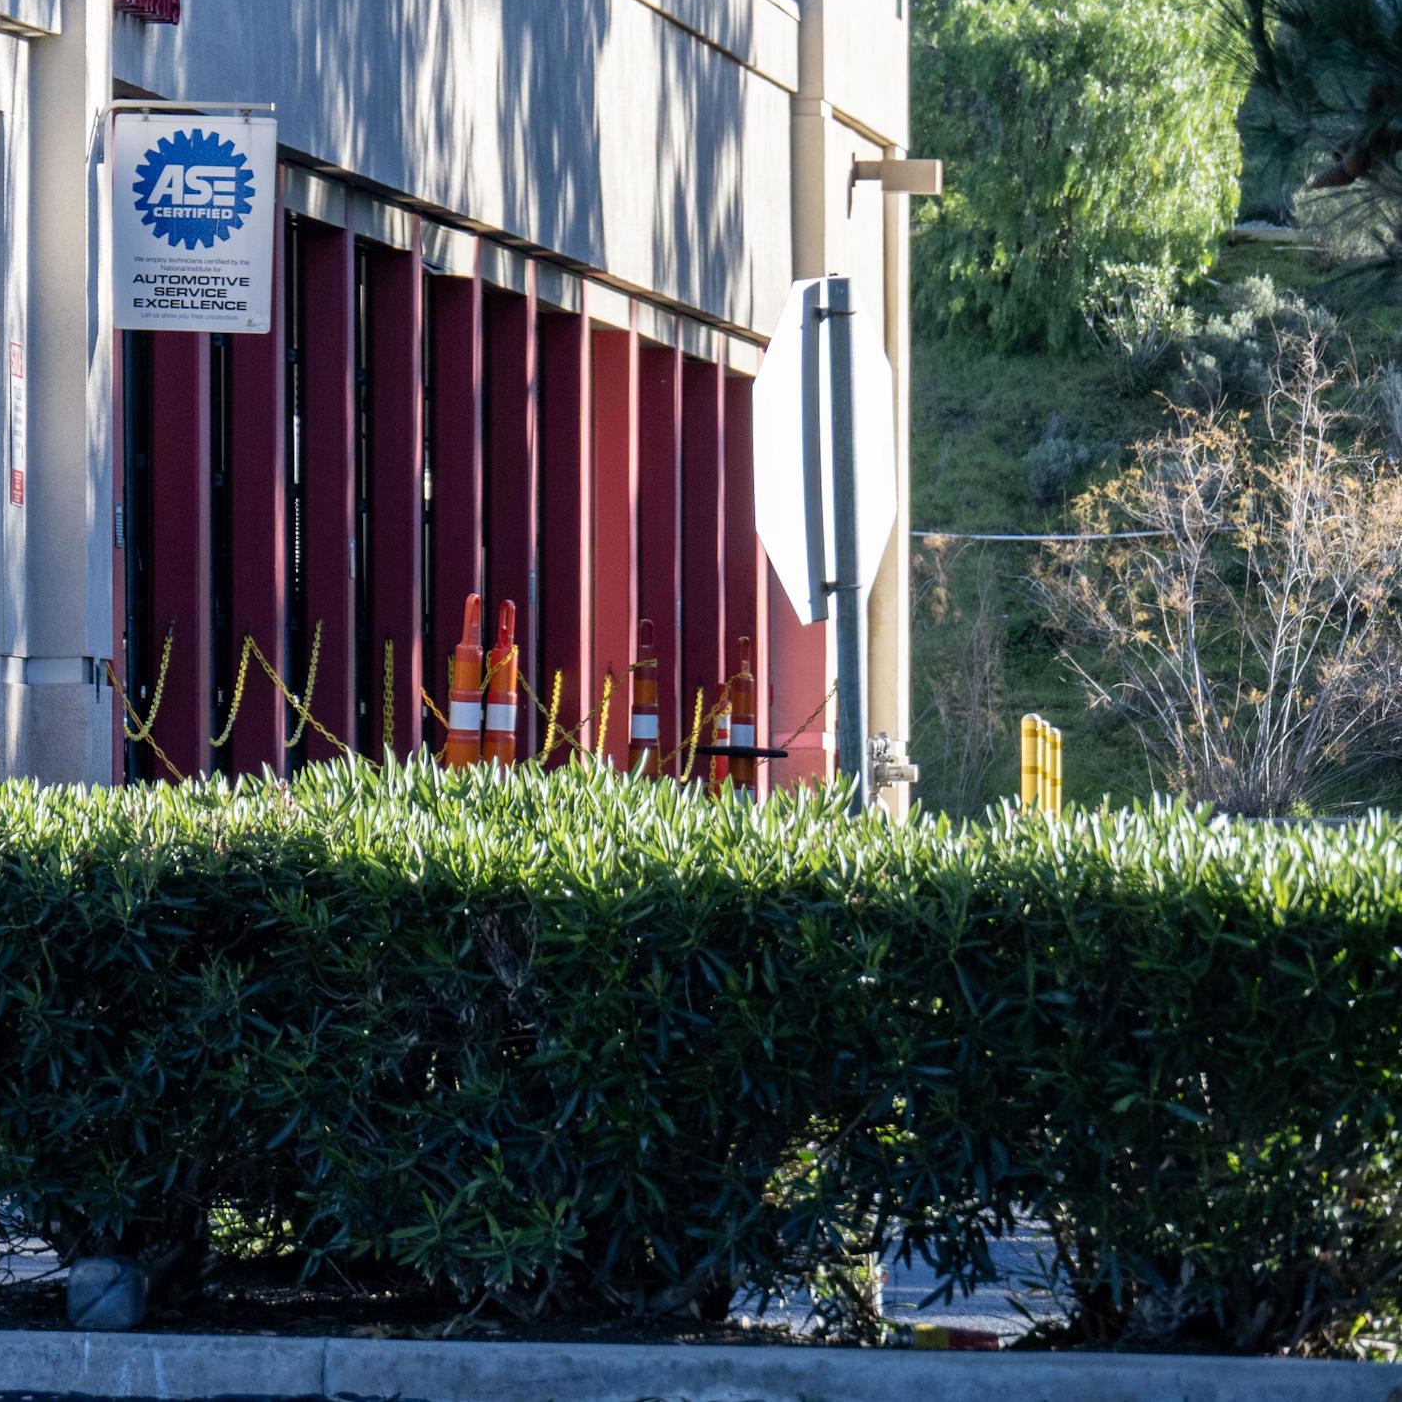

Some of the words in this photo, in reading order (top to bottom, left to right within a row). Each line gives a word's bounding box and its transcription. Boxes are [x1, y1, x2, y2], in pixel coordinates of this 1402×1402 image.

[146, 164, 236, 206] ASE
[152, 207, 233, 220] CERTIFIED
[145, 257, 167, 265] employ
[168, 257, 203, 265] technicians
[160, 264, 186, 272] National
[213, 265, 222, 273] for
[132, 273, 250, 287] AUTOMOTIVE
[154, 286, 228, 298] SERVICE
[133, 298, 248, 311] EXCELLENCE
